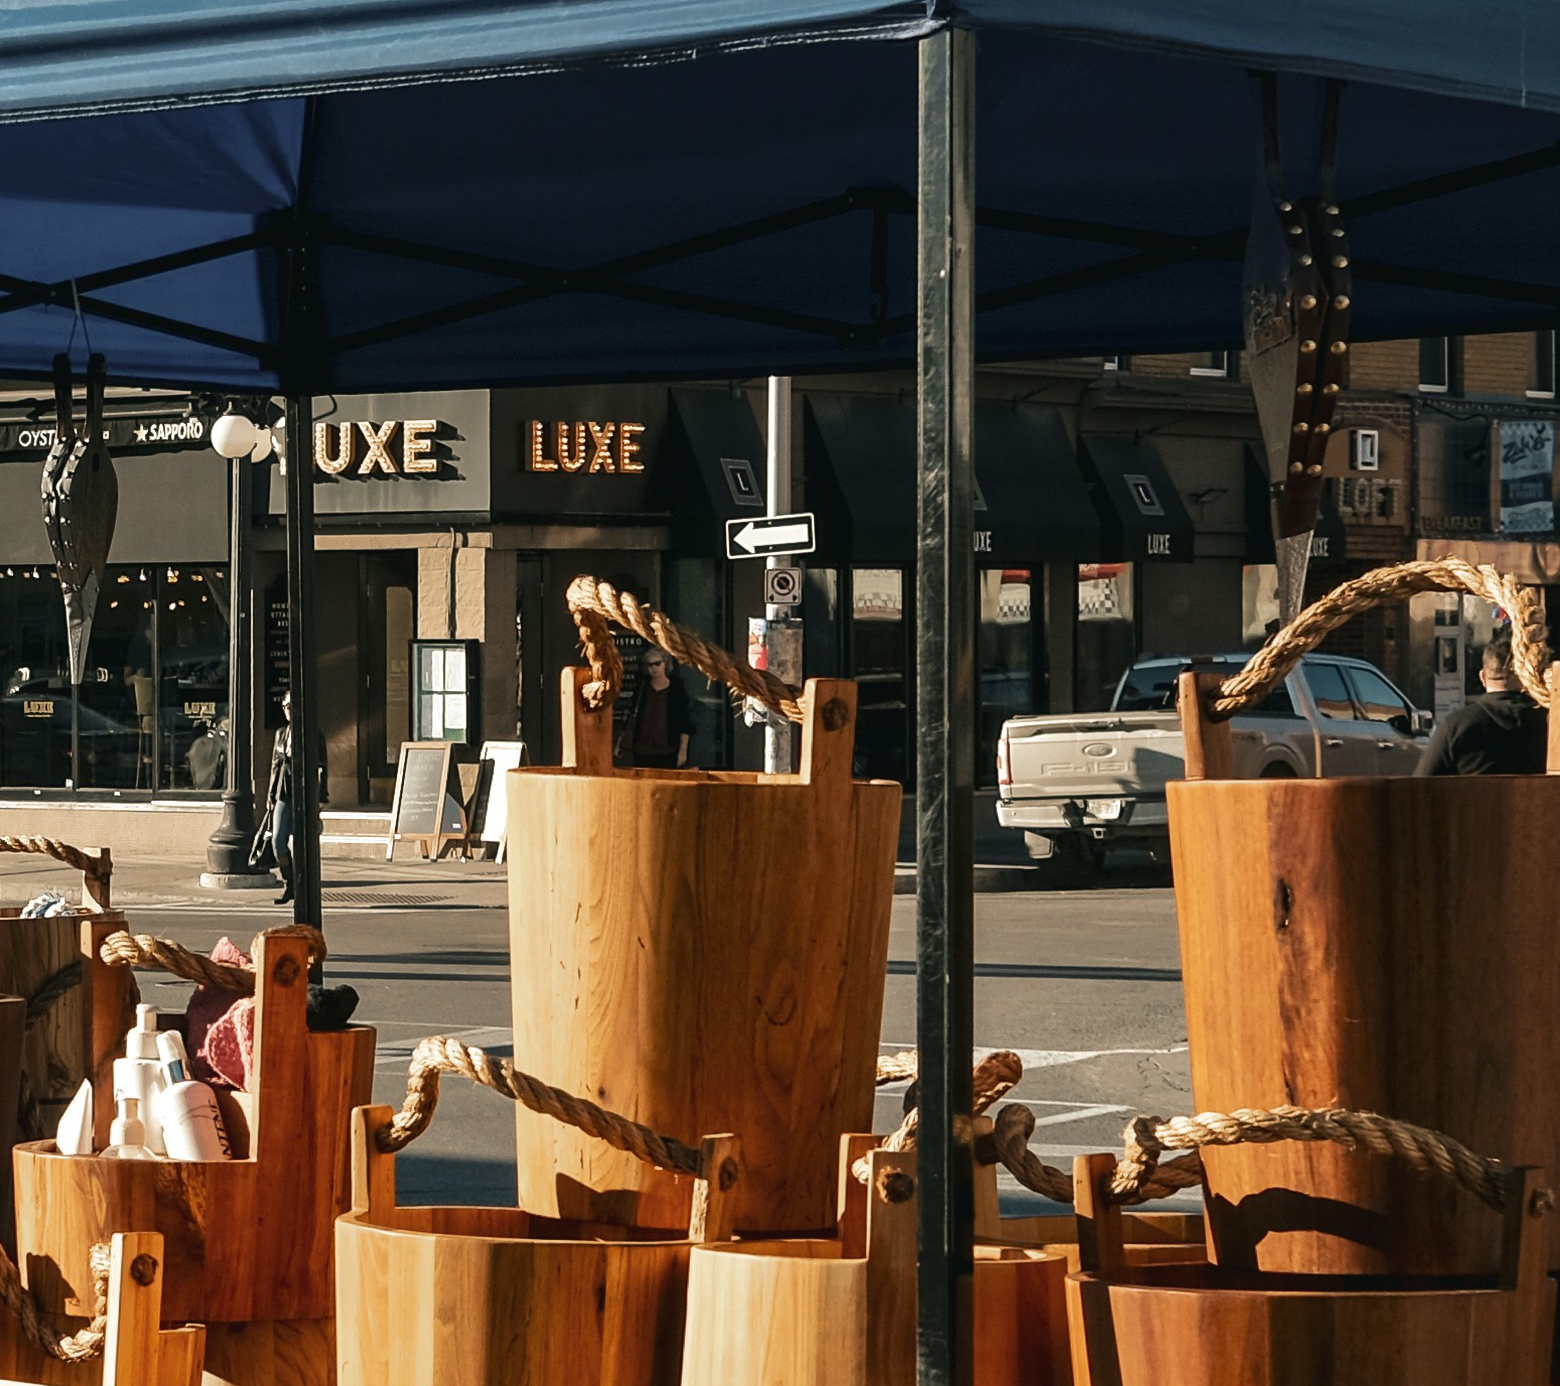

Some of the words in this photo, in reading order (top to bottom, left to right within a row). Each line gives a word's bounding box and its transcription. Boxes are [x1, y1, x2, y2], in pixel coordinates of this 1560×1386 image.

[18, 428, 57, 448] OYST
[149, 421, 204, 442] SAPPORO
[313, 419, 438, 474] UXE
[532, 419, 647, 474] LUXE
[1339, 477, 1403, 519] LOFT
[974, 531, 992, 552] UXE
[1147, 533, 1171, 555] LUXE
[1311, 537, 1329, 557] UXE
[616, 637, 642, 646] ISTRO
[23, 700, 54, 714] LUXE
